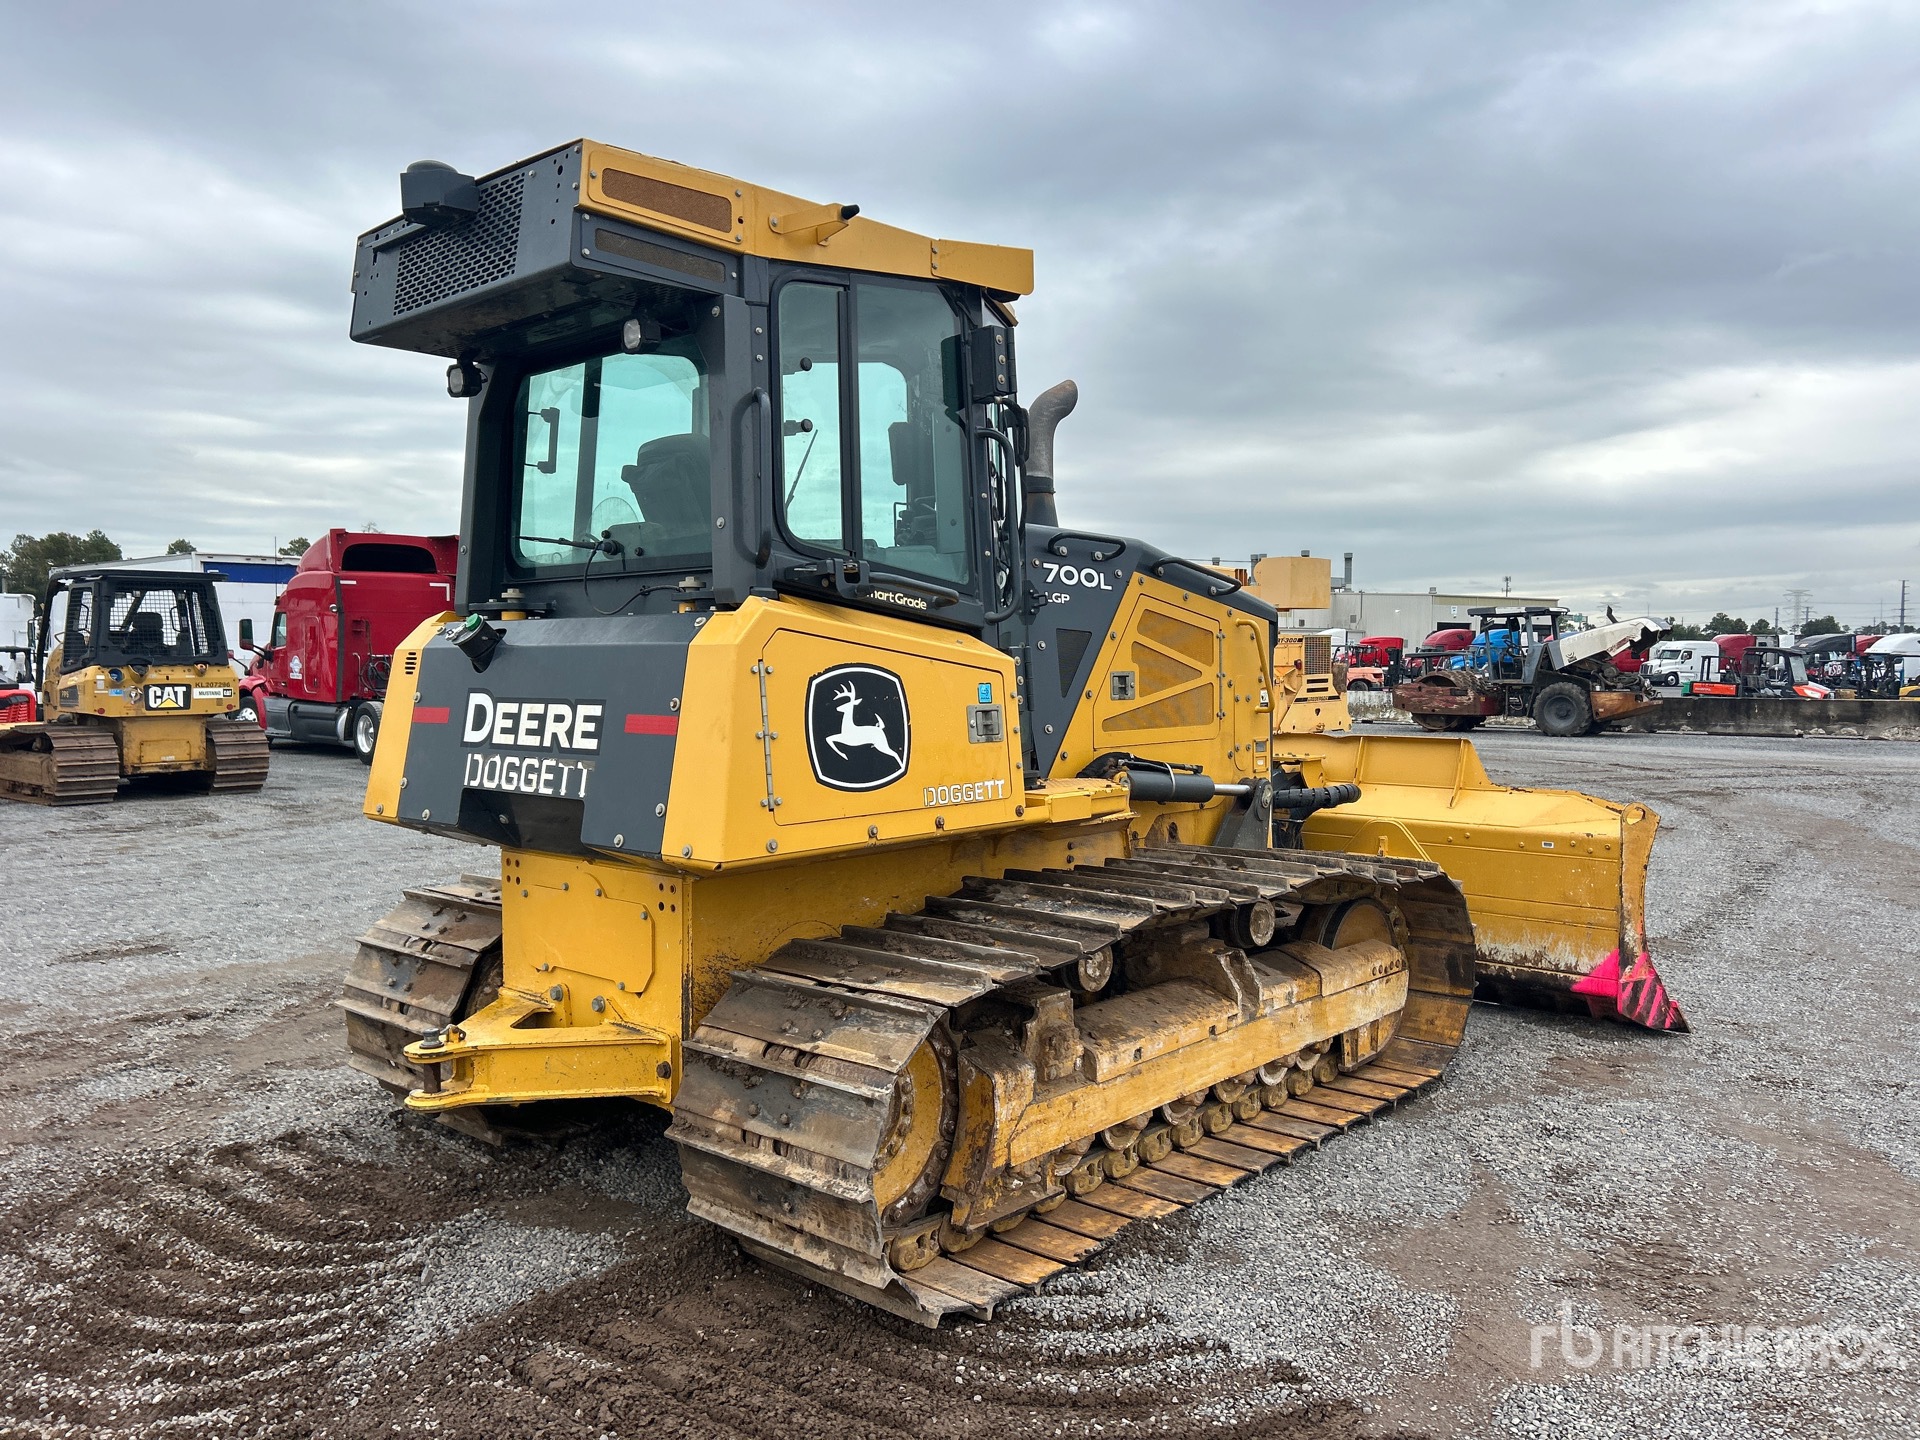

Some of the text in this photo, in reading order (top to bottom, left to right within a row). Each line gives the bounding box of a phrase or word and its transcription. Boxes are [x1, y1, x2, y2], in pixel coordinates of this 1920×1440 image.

[1042, 562, 1113, 591] 700L
[149, 686, 187, 708] CAT
[463, 692, 603, 750] DEERE
[463, 753, 595, 798] DOGGETT
[923, 779, 1005, 807] DOGGETT
